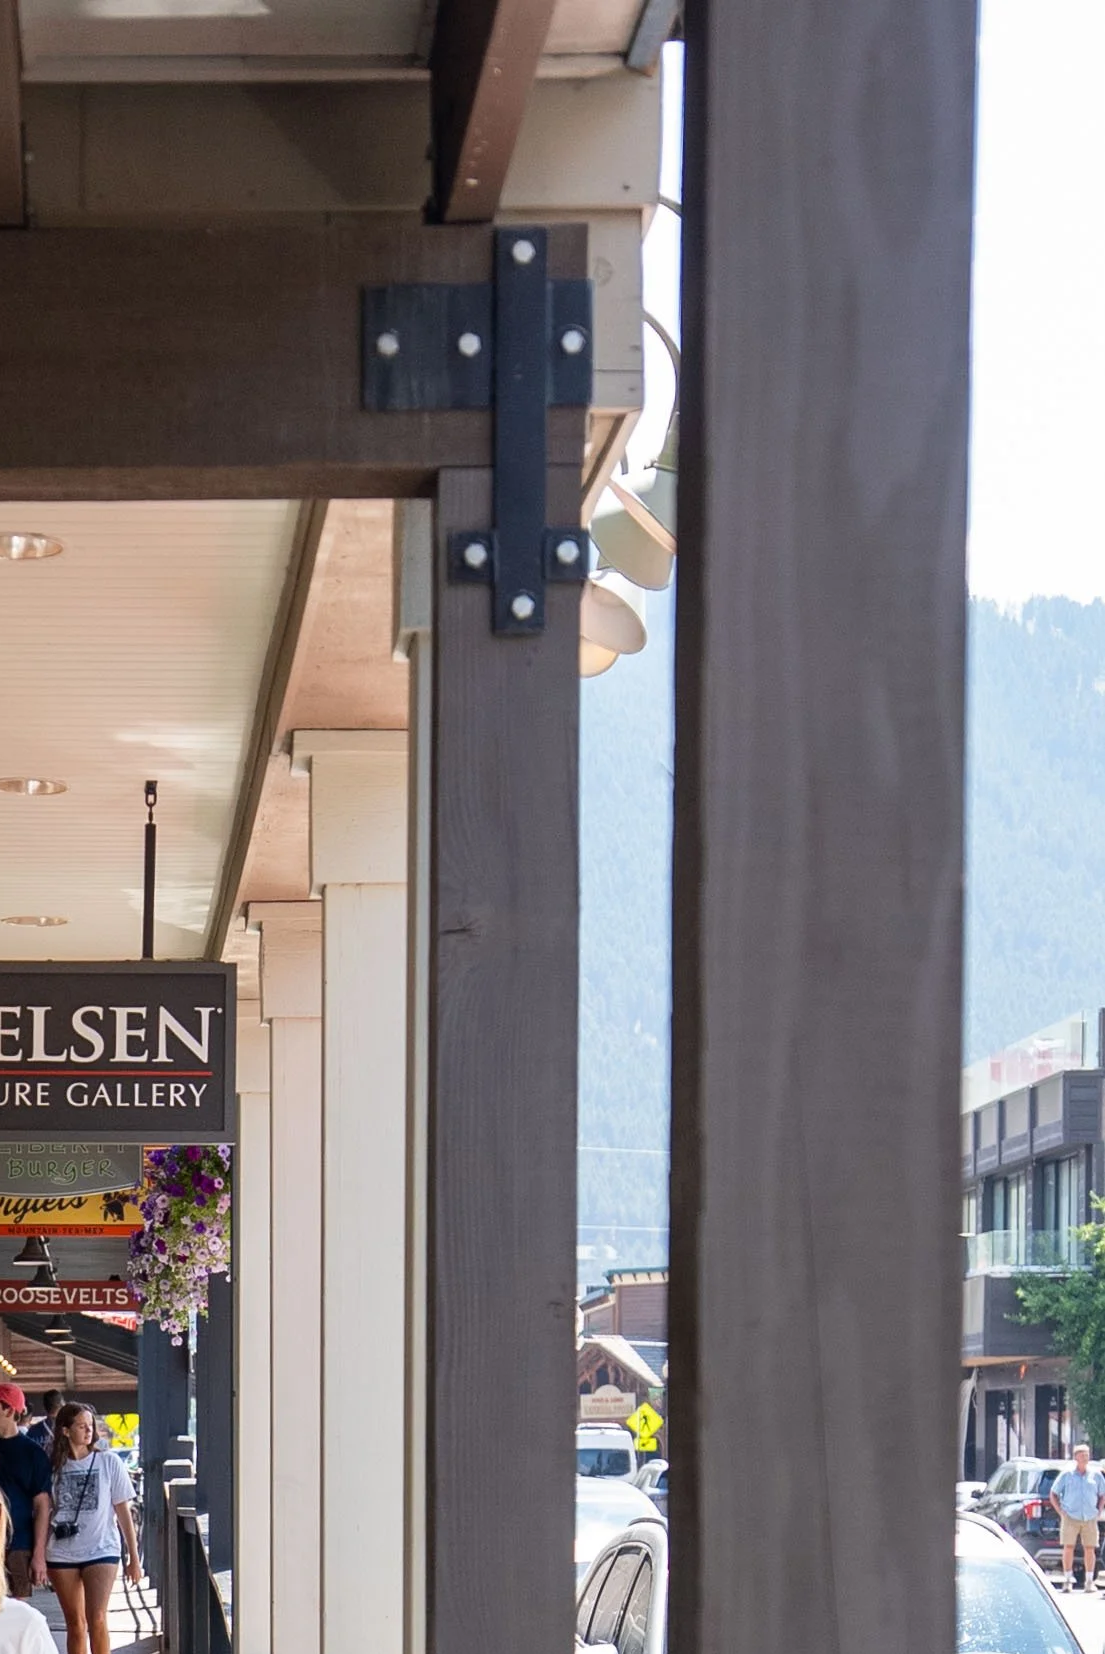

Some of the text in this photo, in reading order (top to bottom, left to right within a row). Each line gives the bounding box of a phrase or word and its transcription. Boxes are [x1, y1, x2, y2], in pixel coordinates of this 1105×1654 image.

[66, 1082, 208, 1107] GALLERY
[7, 1158, 116, 1185] BURGER
[7, 1227, 58, 1235] MOUNTAIN
